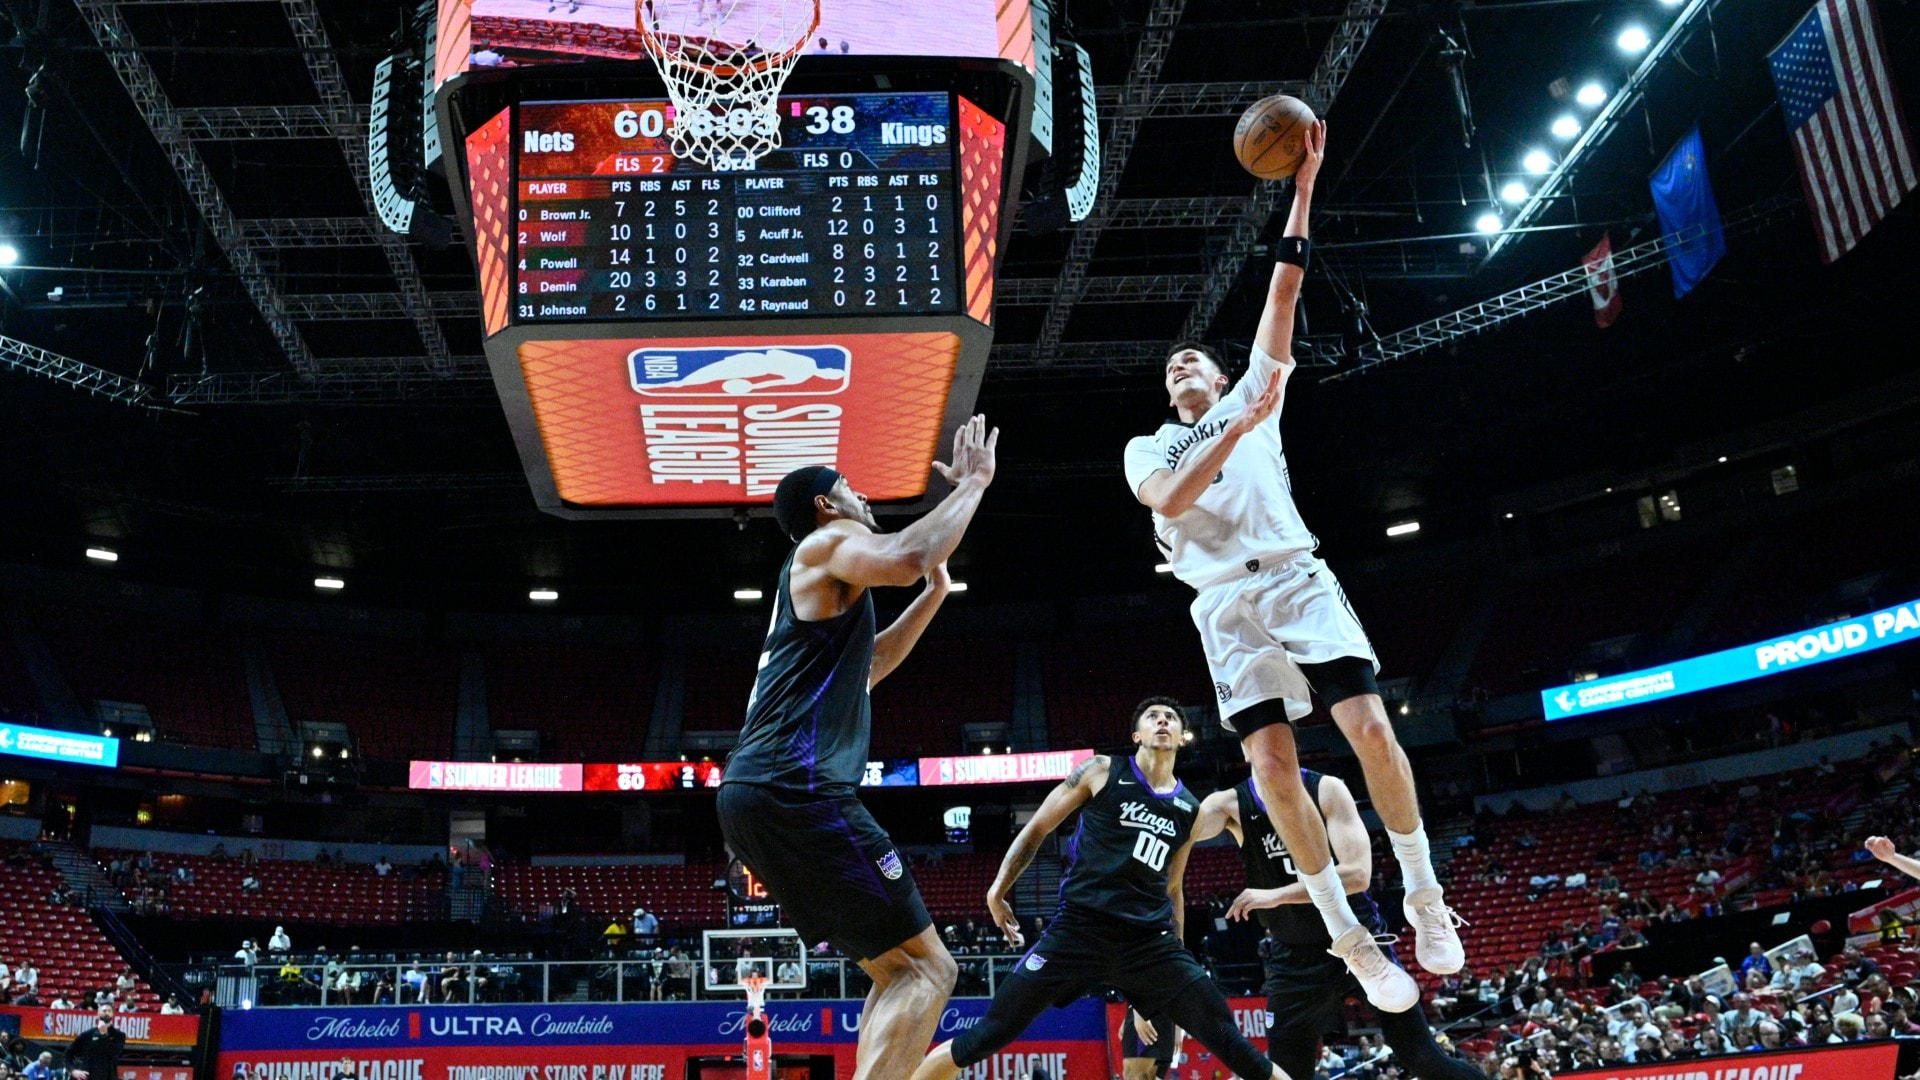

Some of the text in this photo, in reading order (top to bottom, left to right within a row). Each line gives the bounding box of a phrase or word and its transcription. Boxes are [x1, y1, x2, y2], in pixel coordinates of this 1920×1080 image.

[614, 109, 664, 138] 60
[805, 106, 856, 135] 38
[524, 130, 575, 153] Nets
[881, 122, 946, 147] Kings
[615, 156, 664, 173] FLS 2
[803, 151, 852, 169] FLS 0
[529, 179, 720, 194] PLAYER PTS RBS AST FLS
[745, 174, 938, 189] PLAYER PTS RBS AST FLS
[519, 200, 718, 220] 0 Brown Jr. 7 2 5 2
[738, 195, 937, 218] 00 Clifford 2 1 1 0
[519, 223, 719, 244] 2 Wolf 10 1 0 3
[737, 218, 938, 242] 5 Acuff Jr. 12 0 3 1
[519, 247, 719, 270] 4 Powell 14 1 0 2
[738, 242, 939, 266] 32 Cardwell 8 6 1 2
[519, 270, 719, 294] 8 Demin 20 3 3 2
[738, 265, 939, 289] 33 Karaban 2 3 2 1
[519, 293, 720, 317] 31 Johnson 2 6 1 2
[739, 288, 941, 312] 42 Raynaud 0 2 1 2
[643, 355, 679, 379] NBA
[640, 404, 742, 485] LEAGUE
[1167, 418, 1229, 473] BROOKLY
[1756, 600, 1920, 670] PROUD PA
[444, 766, 562, 788] SUMMER LEAGUE
[955, 753, 1075, 781] SUMMER LEAGUE
[618, 773, 645, 790] 60
[1119, 801, 1176, 837] Kings
[1132, 830, 1170, 872] 00
[745, 904, 775, 912] TISSOT
[56, 1013, 151, 1040] SUMM EAGUE
[306, 1013, 614, 1040] Michelob ULTRA Courtside
[718, 1011, 812, 1035] Mhelob
[544, 1064, 588, 1080] STARS
[631, 1063, 666, 1080] HERE
